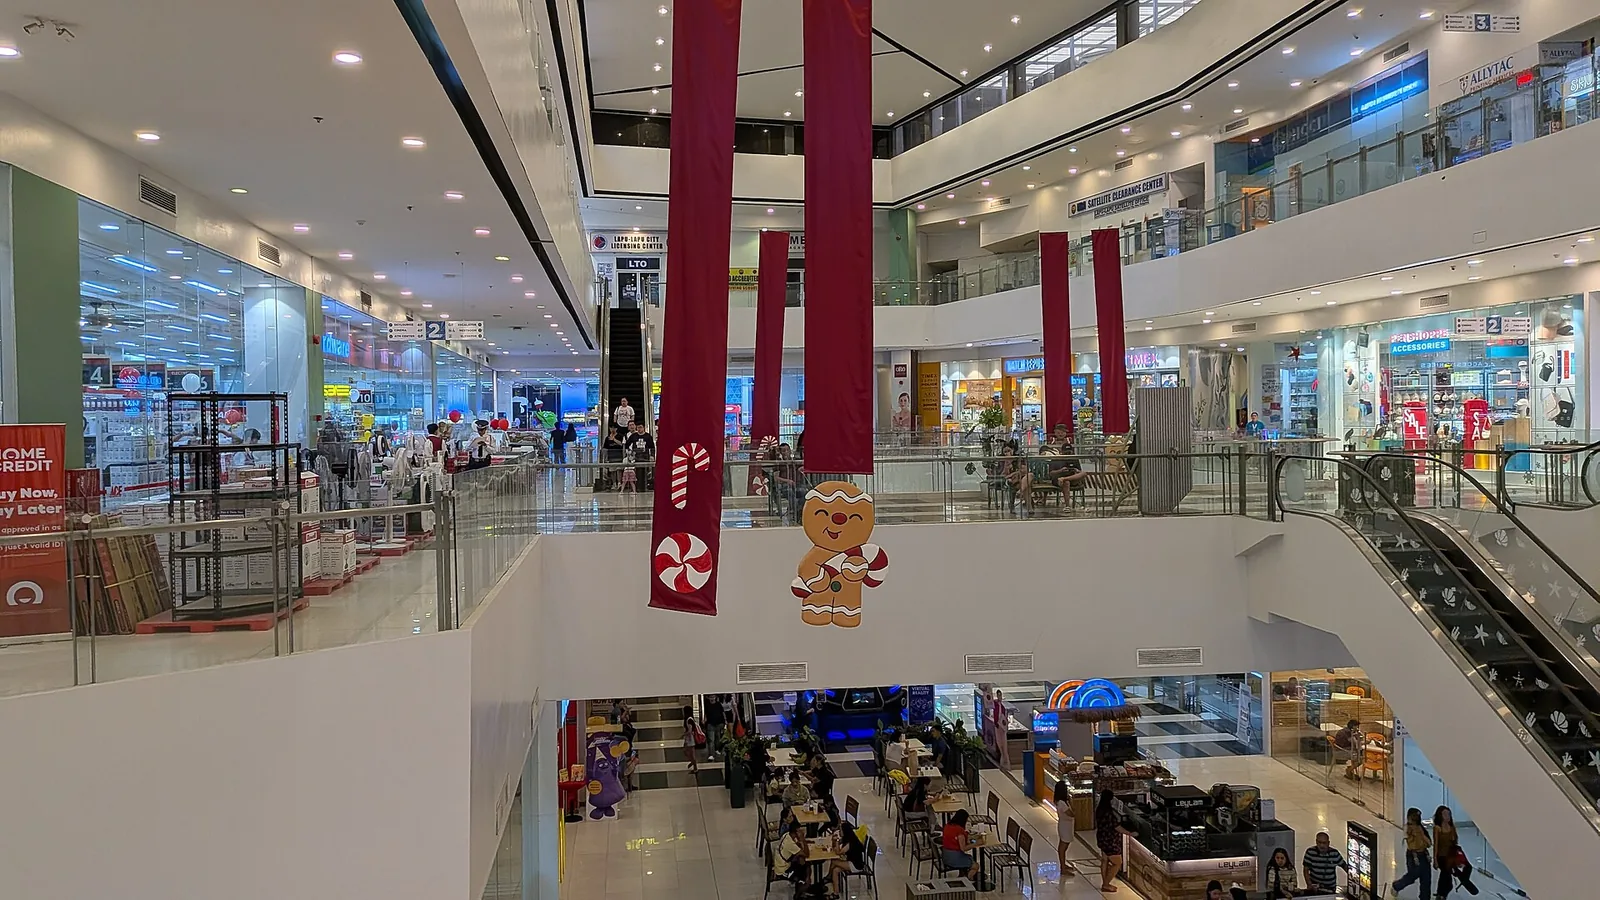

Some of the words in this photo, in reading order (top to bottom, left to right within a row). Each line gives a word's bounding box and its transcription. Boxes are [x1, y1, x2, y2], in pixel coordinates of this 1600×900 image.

[1476, 15, 1487, 30] 3
[1470, 56, 1514, 85] ALLYTAC
[1088, 193, 1111, 208] SATELLITE
[1112, 184, 1142, 201] CLEARANCE
[1142, 177, 1164, 191] CENTER
[628, 260, 648, 268] LTO
[428, 322, 443, 339] 2
[1488, 319, 1500, 333] 2
[1392, 341, 1446, 354] ACCESSORIES
[90, 366, 104, 384] 4
[360, 393, 371, 403] 10
[1403, 409, 1427, 440] SALE
[0, 447, 46, 460] OME
[0, 460, 53, 472] REDIT
[20, 487, 59, 499] Now,
[17, 503, 63, 515] Later
[1, 524, 41, 535] approved
[4, 544, 22, 552] just
[30, 541, 51, 549] valid
